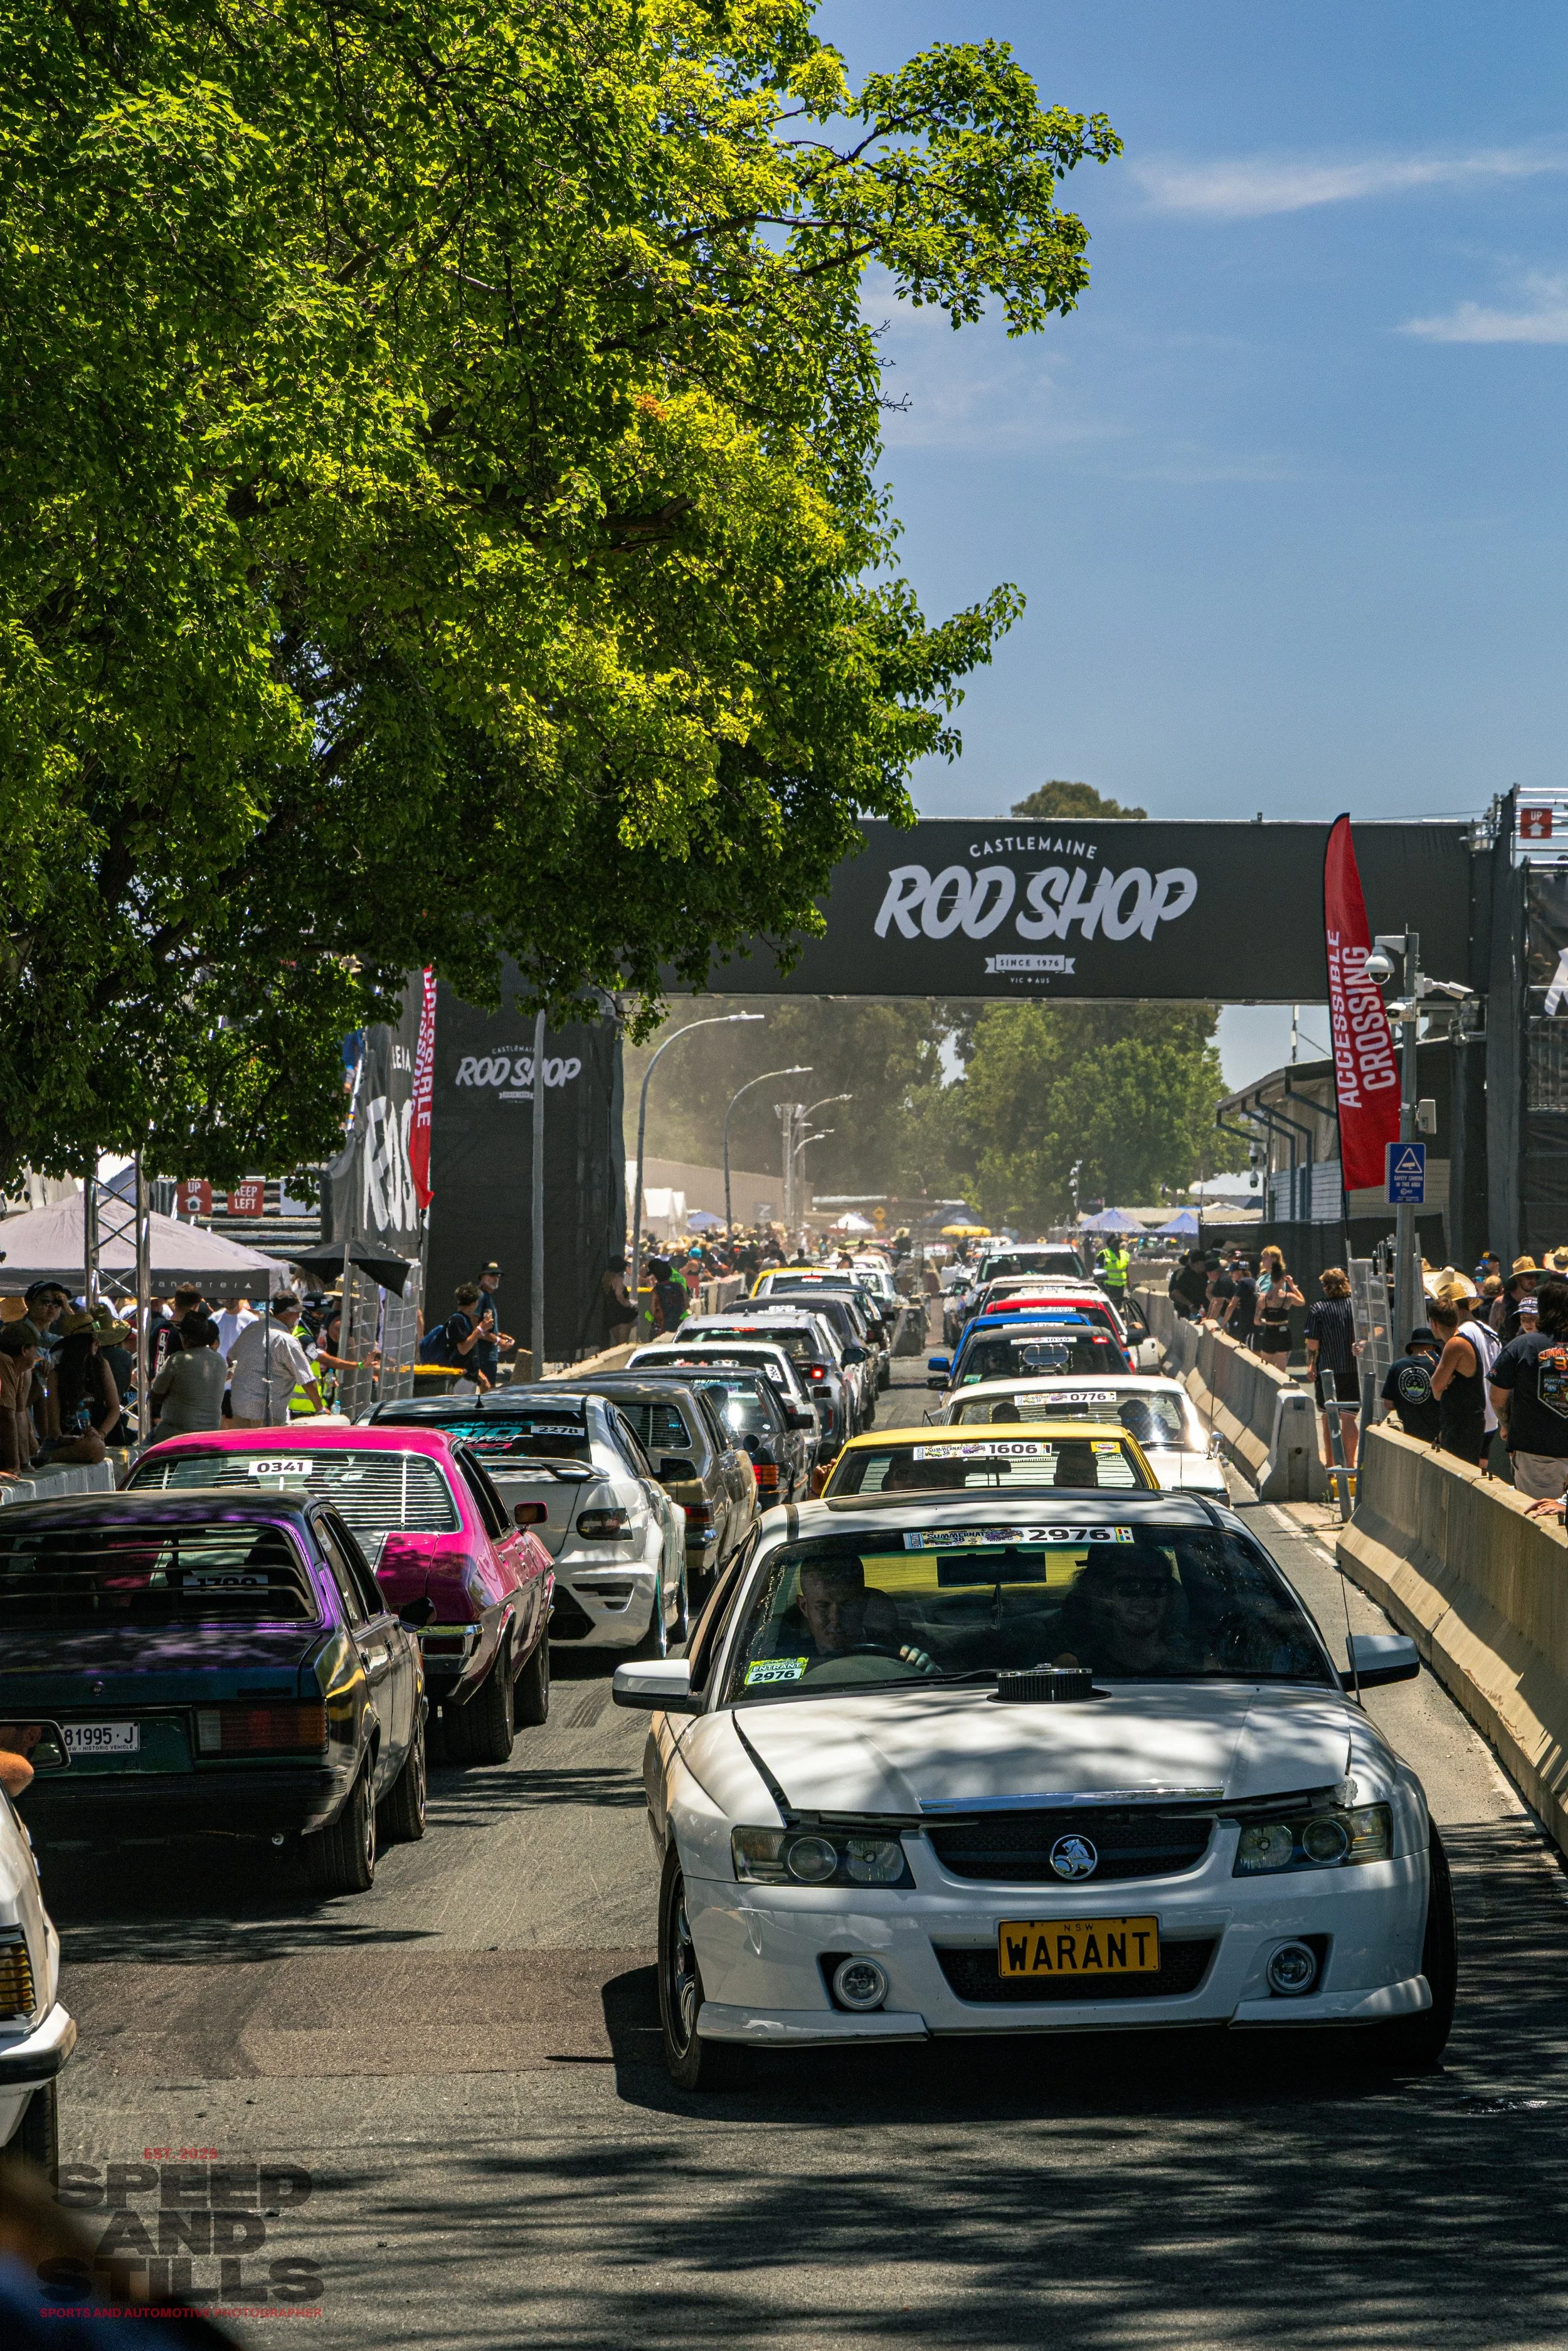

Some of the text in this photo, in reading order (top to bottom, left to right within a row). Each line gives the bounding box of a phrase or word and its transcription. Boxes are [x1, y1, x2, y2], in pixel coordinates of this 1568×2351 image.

[1530, 811, 1542, 821] UP
[970, 836, 1098, 859] CASTLEMAINE
[874, 865, 1198, 941] ROD SHOP
[1000, 958, 1059, 967] SINCE 1976
[1327, 929, 1362, 1108] ACCESSIBLE
[1342, 946, 1396, 1091] CROSSING
[455, 1056, 511, 1086] ROD
[188, 1182, 201, 1193] UP
[235, 1198, 256, 1209] LEFT
[1070, 1393, 1106, 1401] 0776
[539, 1426, 578, 1434] 2278
[989, 1445, 1037, 1454] 1606
[257, 1462, 304, 1473] 0341
[927, 1529, 1111, 1541] SUMMERNATS 2976
[752, 1663, 802, 1672] ENTRANT
[752, 1670, 795, 1682] 2976
[1064, 1923, 1094, 1932] NSW
[1006, 1931, 1150, 1971] WARANT
